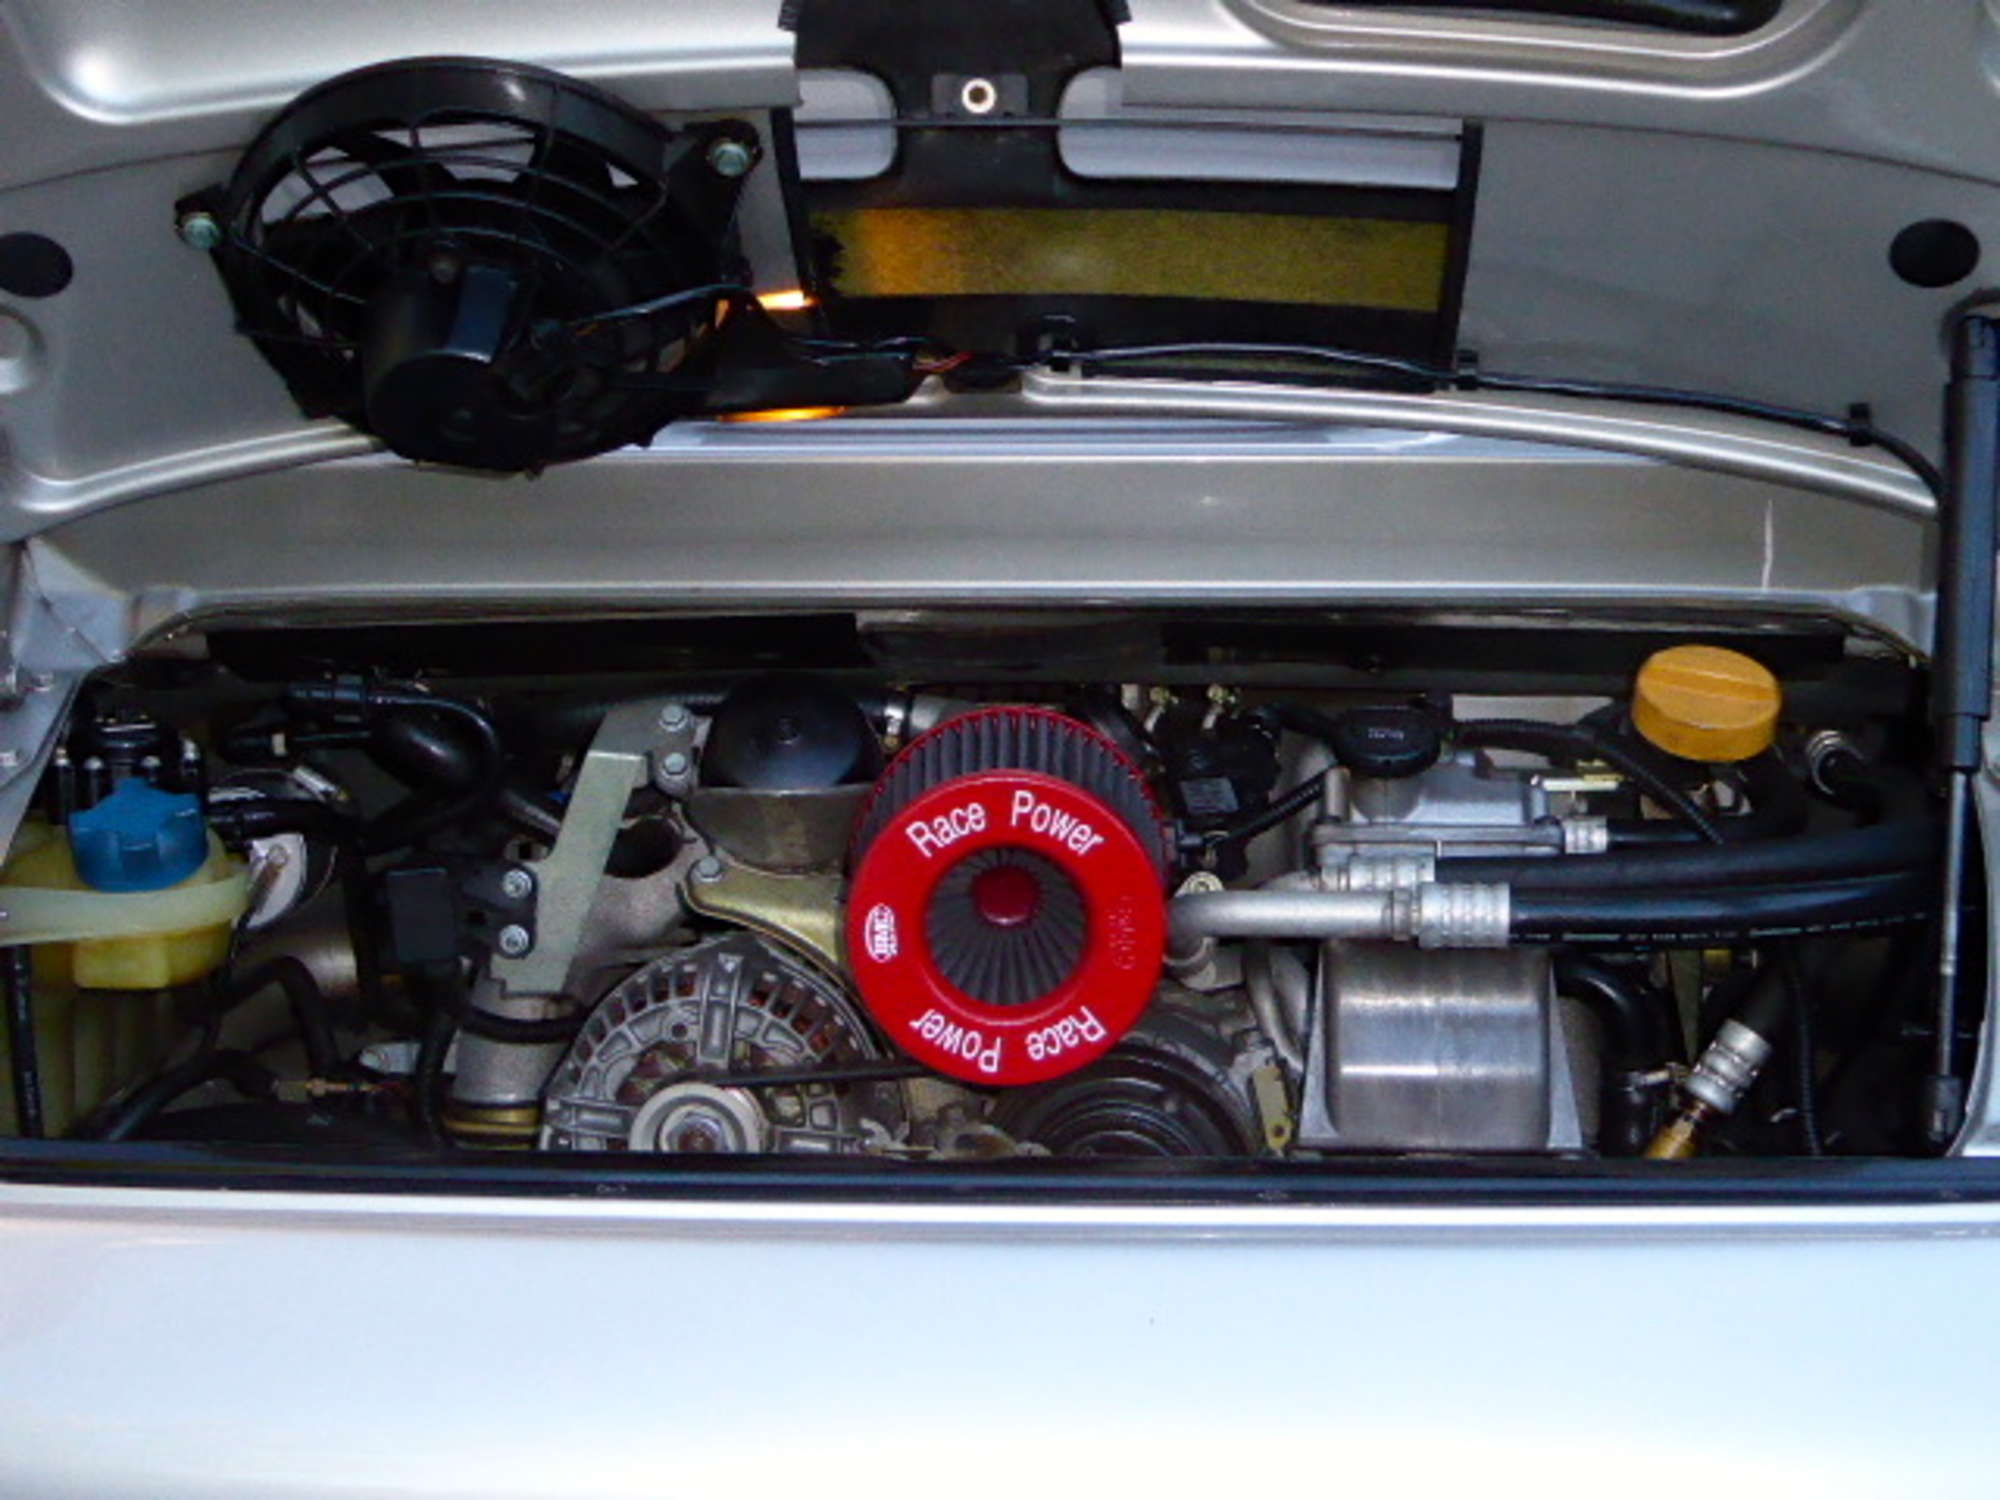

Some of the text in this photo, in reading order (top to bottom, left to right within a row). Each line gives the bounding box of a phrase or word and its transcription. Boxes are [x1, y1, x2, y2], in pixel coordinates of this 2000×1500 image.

[905, 790, 1104, 858] Race Power
[909, 1006, 1107, 1073] Race Power
